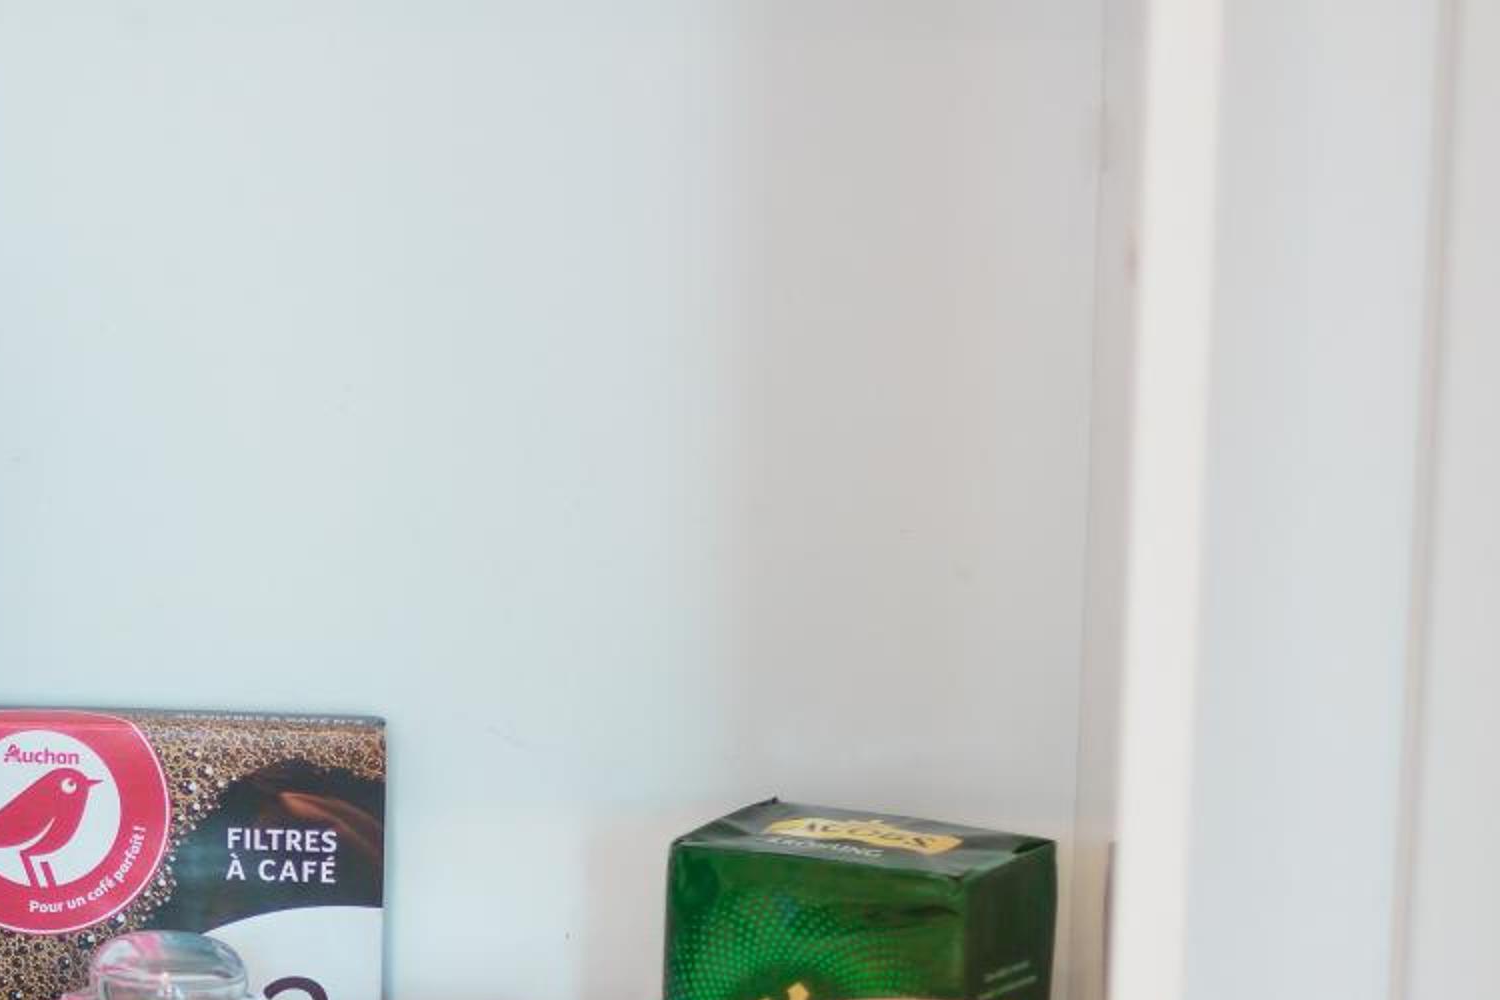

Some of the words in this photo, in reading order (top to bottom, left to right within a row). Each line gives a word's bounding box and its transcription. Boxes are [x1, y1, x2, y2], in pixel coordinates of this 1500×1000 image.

[4, 744, 79, 764] Auchan
[227, 828, 338, 853] FILTRES
[226, 853, 246, 881] À
[258, 855, 336, 883] CAFÉ
[28, 900, 63, 913] Pour
[67, 895, 87, 909] un
[87, 873, 116, 901] café
